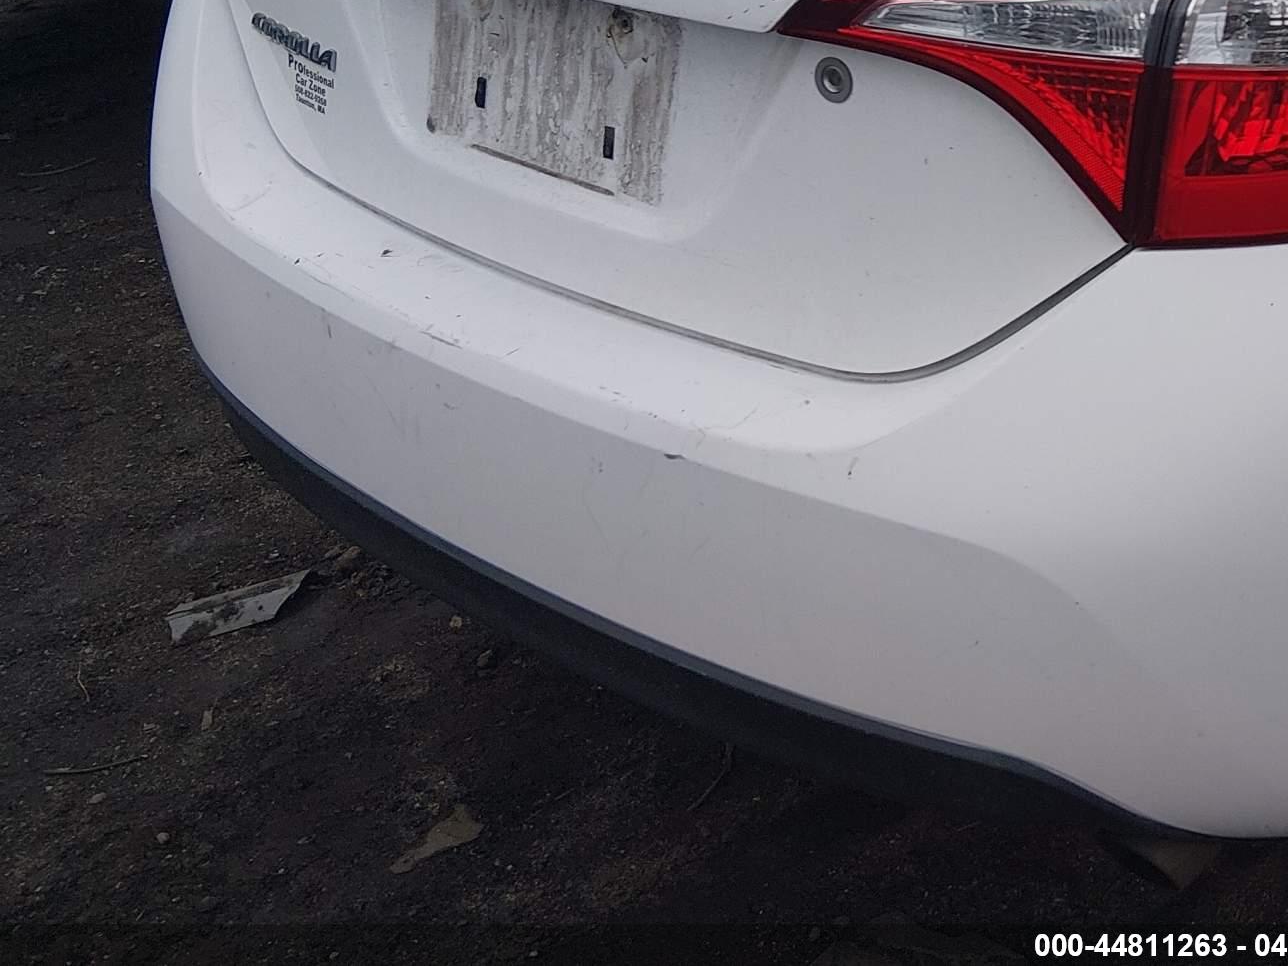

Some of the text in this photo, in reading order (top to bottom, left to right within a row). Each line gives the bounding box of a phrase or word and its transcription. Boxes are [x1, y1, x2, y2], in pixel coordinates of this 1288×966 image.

[251, 12, 338, 73] COROLLA
[295, 73, 326, 97] Car Zone
